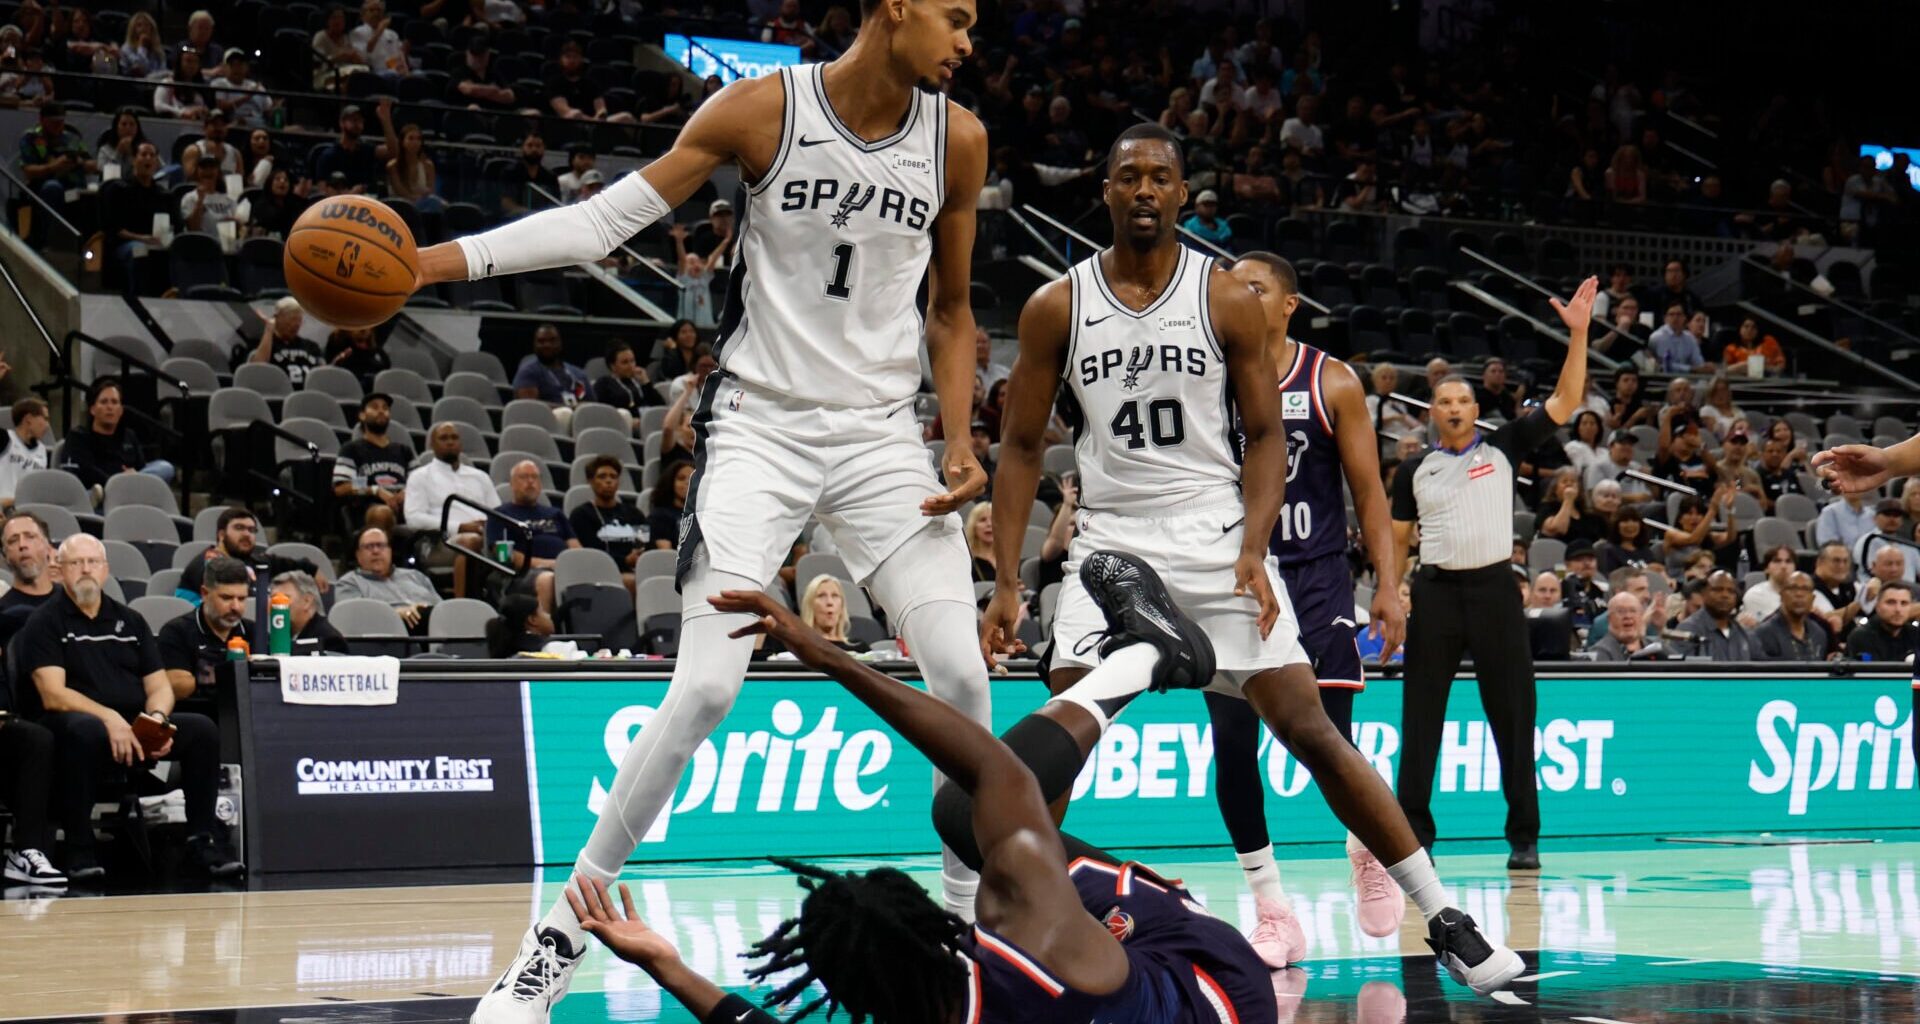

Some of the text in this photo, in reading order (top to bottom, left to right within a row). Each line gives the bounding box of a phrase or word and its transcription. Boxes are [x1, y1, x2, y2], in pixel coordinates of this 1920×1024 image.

[720, 52, 783, 83] Fros
[897, 158, 927, 169] LEDGER
[781, 179, 930, 231] SPURS
[321, 203, 404, 250] Wilson
[824, 241, 856, 301] 1
[1163, 320, 1192, 328] LEDGER
[1080, 345, 1207, 390] SPURS
[1109, 397, 1187, 451] 40
[1280, 501, 1312, 541] 10
[272, 614, 285, 629] G
[302, 673, 389, 692] BASKETBALL
[296, 755, 493, 782] COMMUNITY FIRST
[329, 779, 466, 793] HEALTH PLANS
